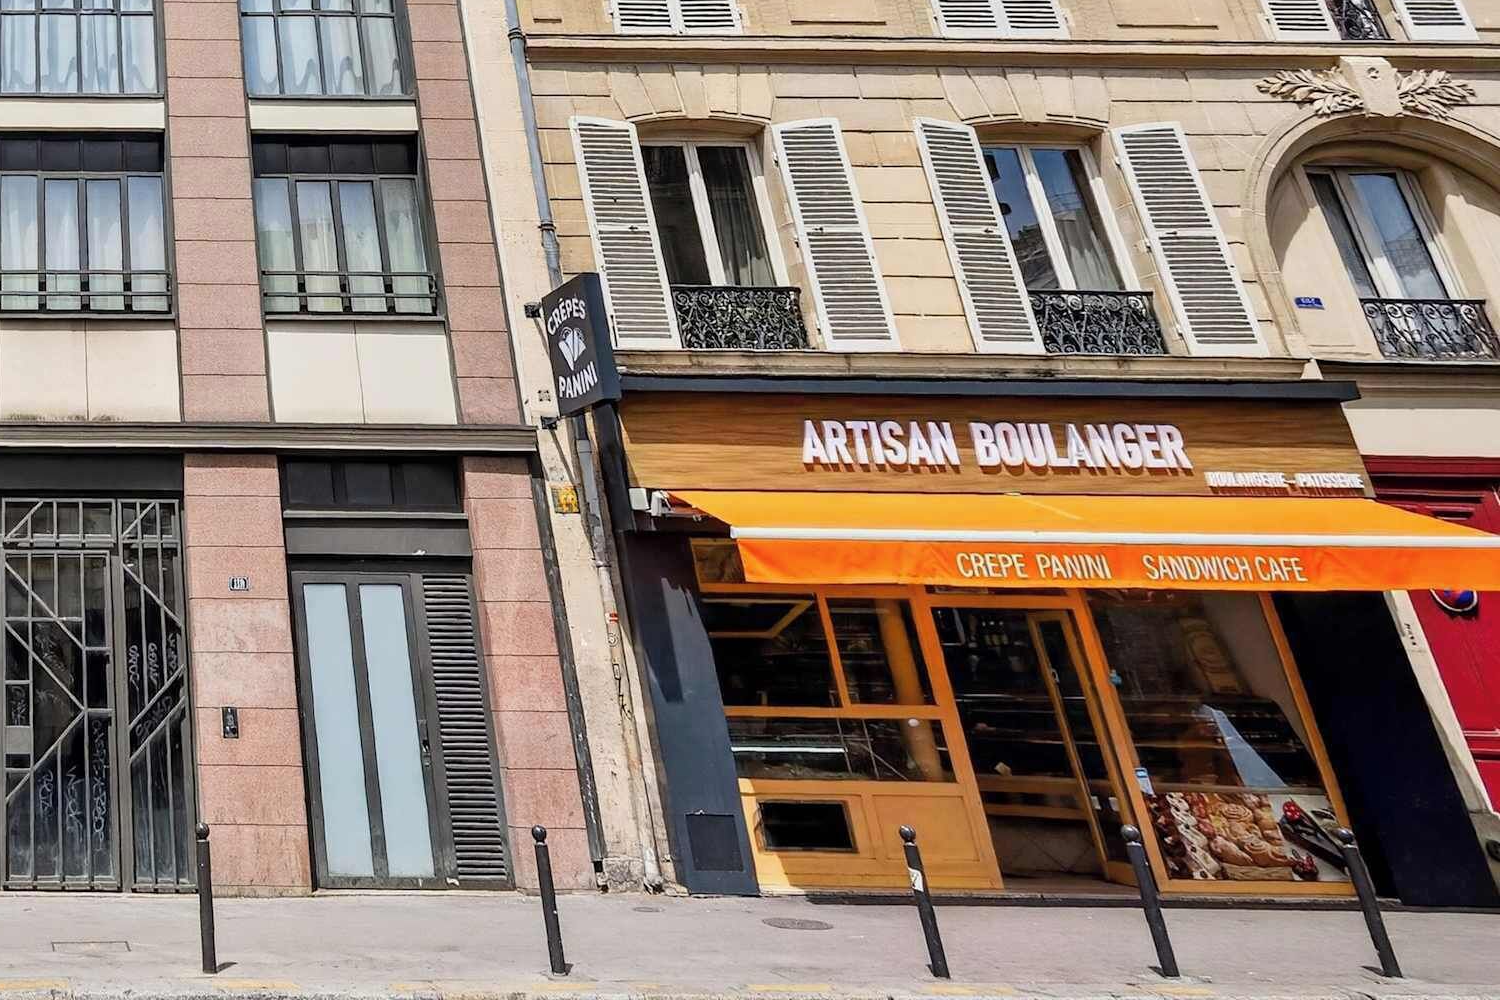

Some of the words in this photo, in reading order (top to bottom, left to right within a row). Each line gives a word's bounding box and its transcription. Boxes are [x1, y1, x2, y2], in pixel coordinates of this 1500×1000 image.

[558, 361, 598, 398] PANINI
[802, 419, 962, 466] ARTISAN
[968, 421, 1194, 469] BOULANGER
[956, 552, 1029, 579] CREPE
[1035, 553, 1112, 580] PANINI
[1141, 554, 1253, 581] SANDWICH
[1254, 556, 1309, 582] CAFE
